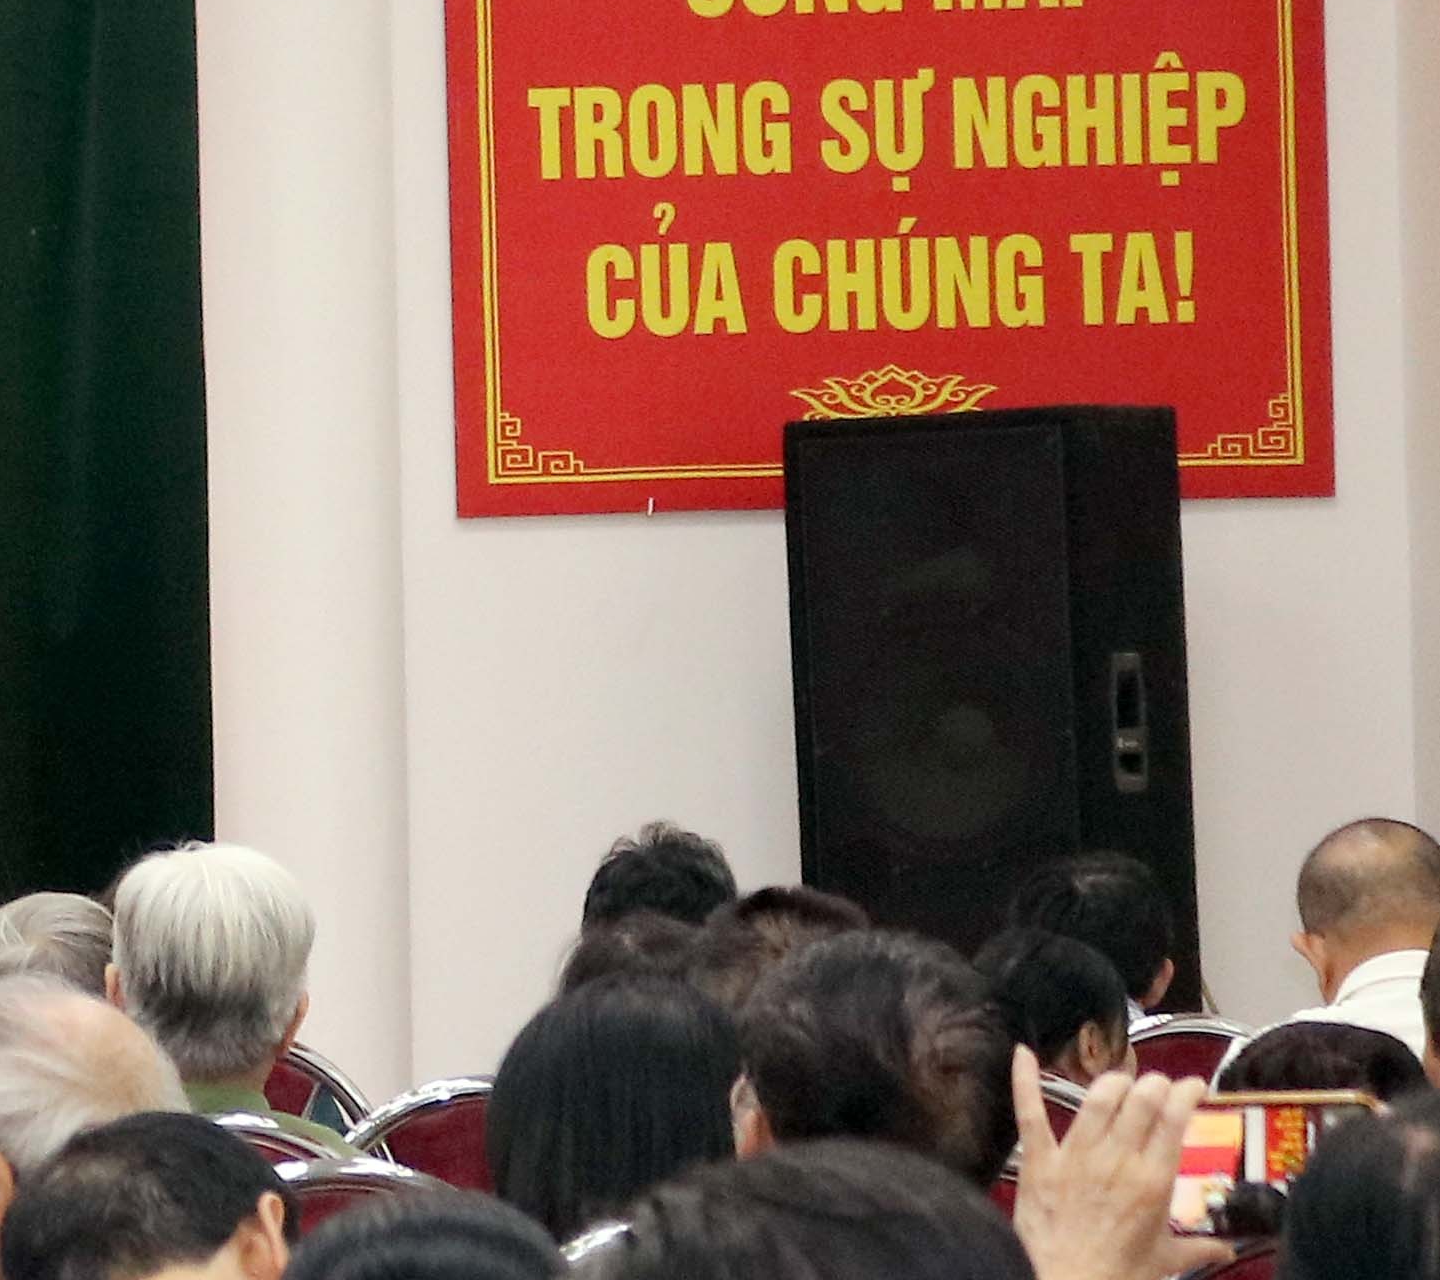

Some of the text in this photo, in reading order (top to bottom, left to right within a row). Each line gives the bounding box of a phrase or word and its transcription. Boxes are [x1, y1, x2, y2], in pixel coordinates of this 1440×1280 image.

[528, 52, 1245, 191] TRONG SỰ NGHIỆP
[587, 203, 1194, 338] CỦA CHÚNG TA!
